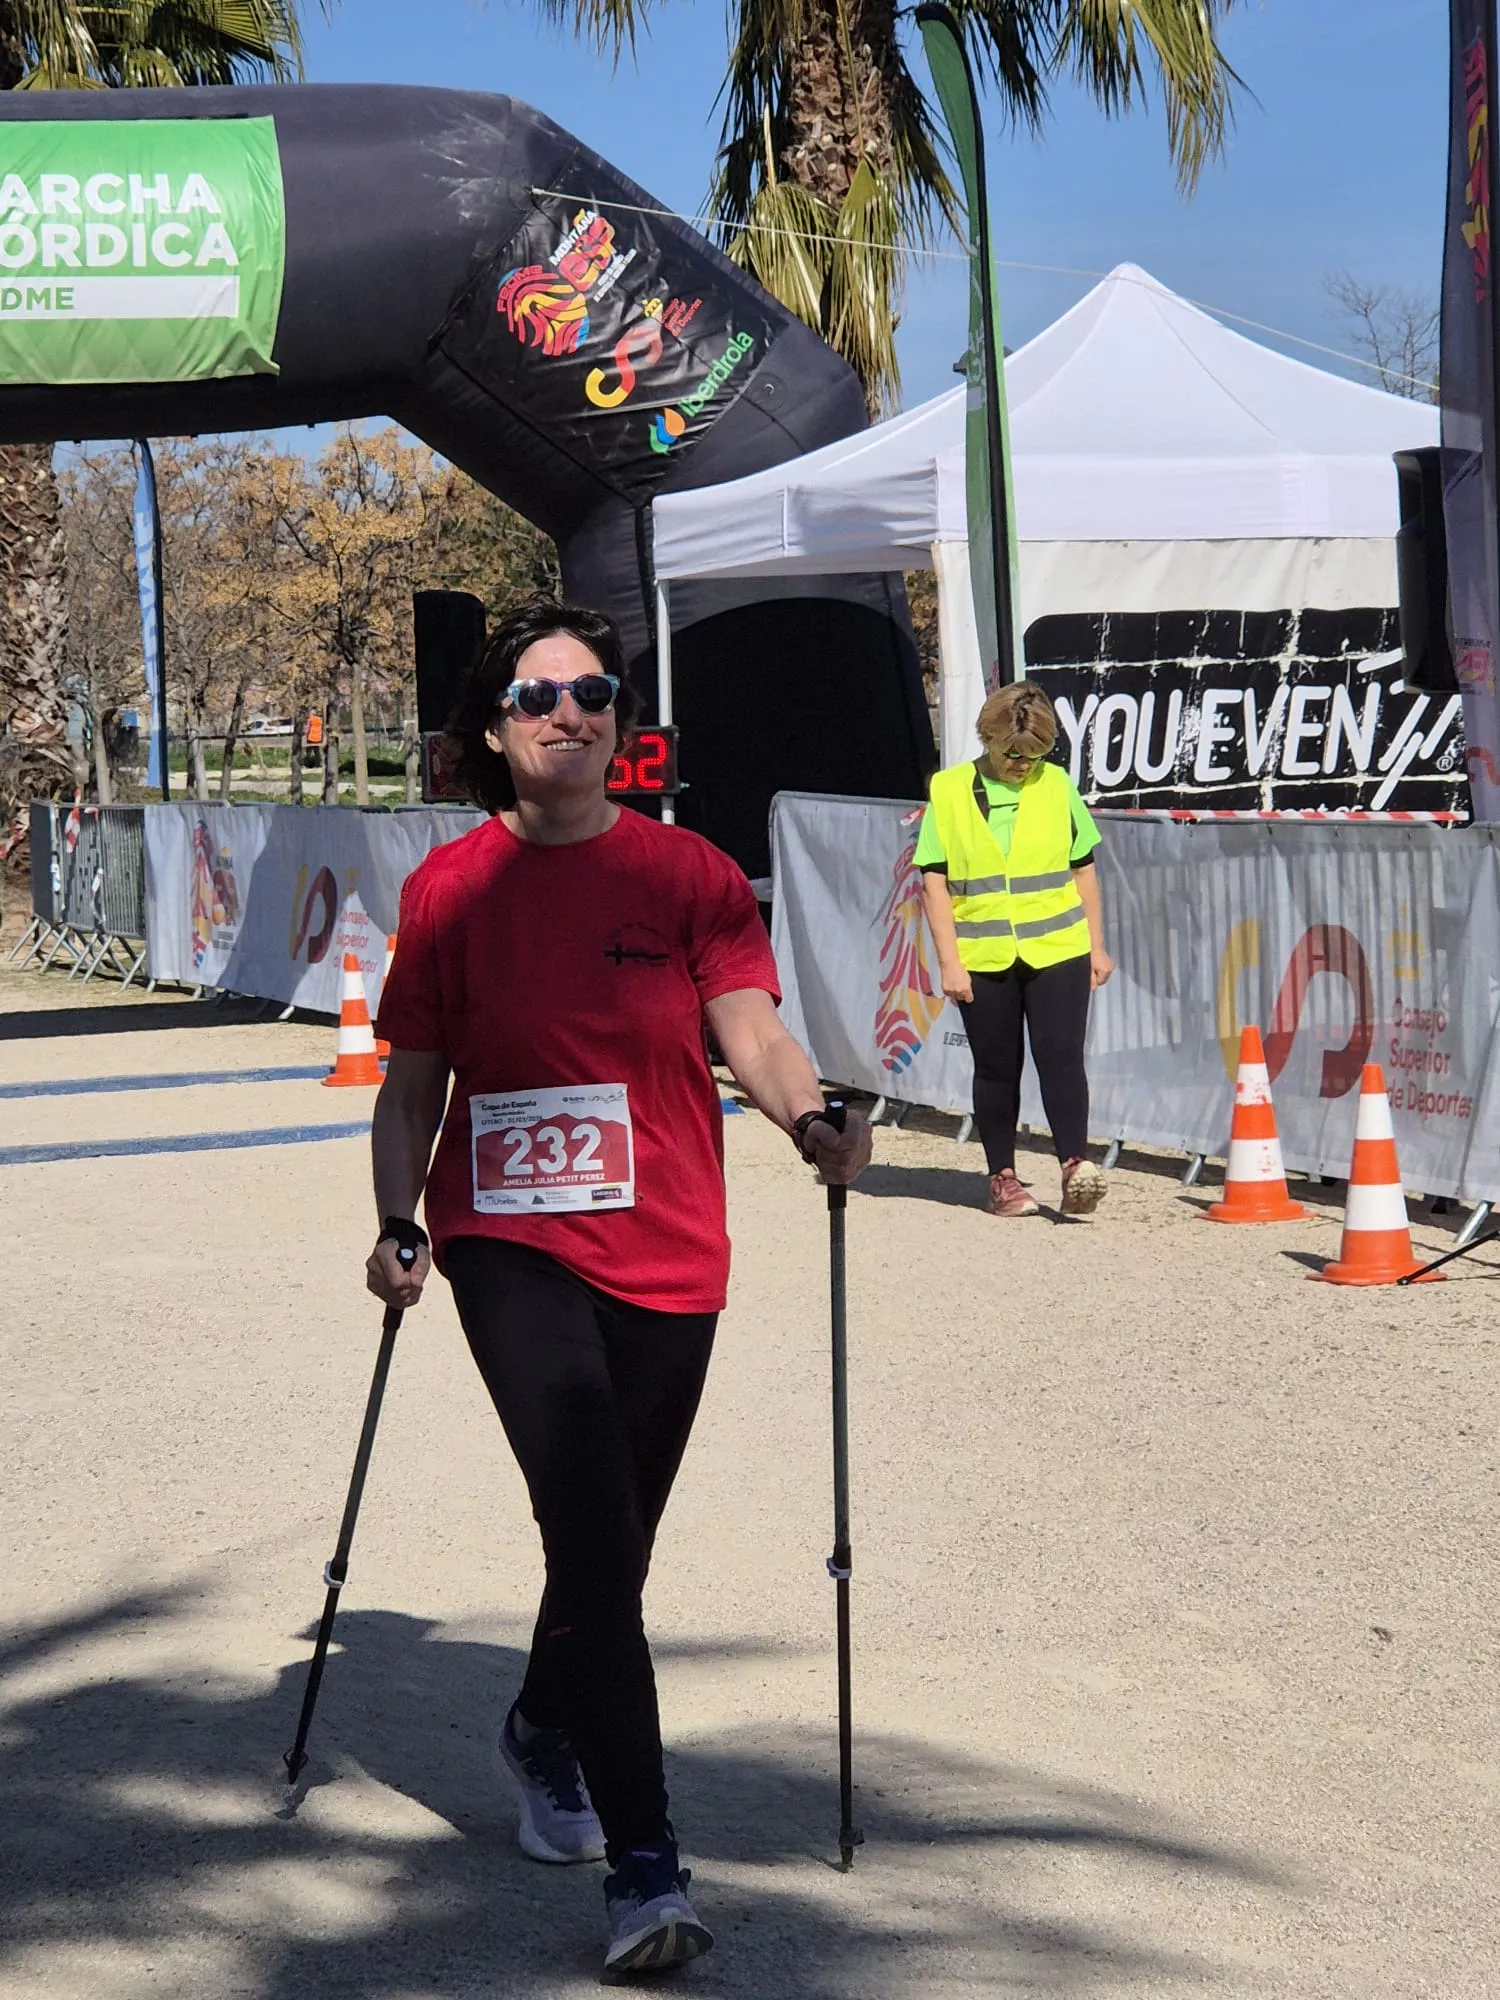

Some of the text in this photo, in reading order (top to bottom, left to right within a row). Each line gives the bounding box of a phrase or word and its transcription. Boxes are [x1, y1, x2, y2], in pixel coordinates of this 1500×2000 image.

[0, 173, 222, 214] ARCHA
[0, 211, 240, 268] ÓRDICA
[0, 286, 76, 312] DME
[678, 331, 755, 417] Iberdrola
[1391, 997, 1446, 1039] Consejo
[1389, 1038, 1451, 1077] Superior
[1407, 1080, 1473, 1120] Deportes
[503, 1123, 604, 1176] 232
[503, 1173, 605, 1186] AMELIA JULIA PETIT PEREZ
